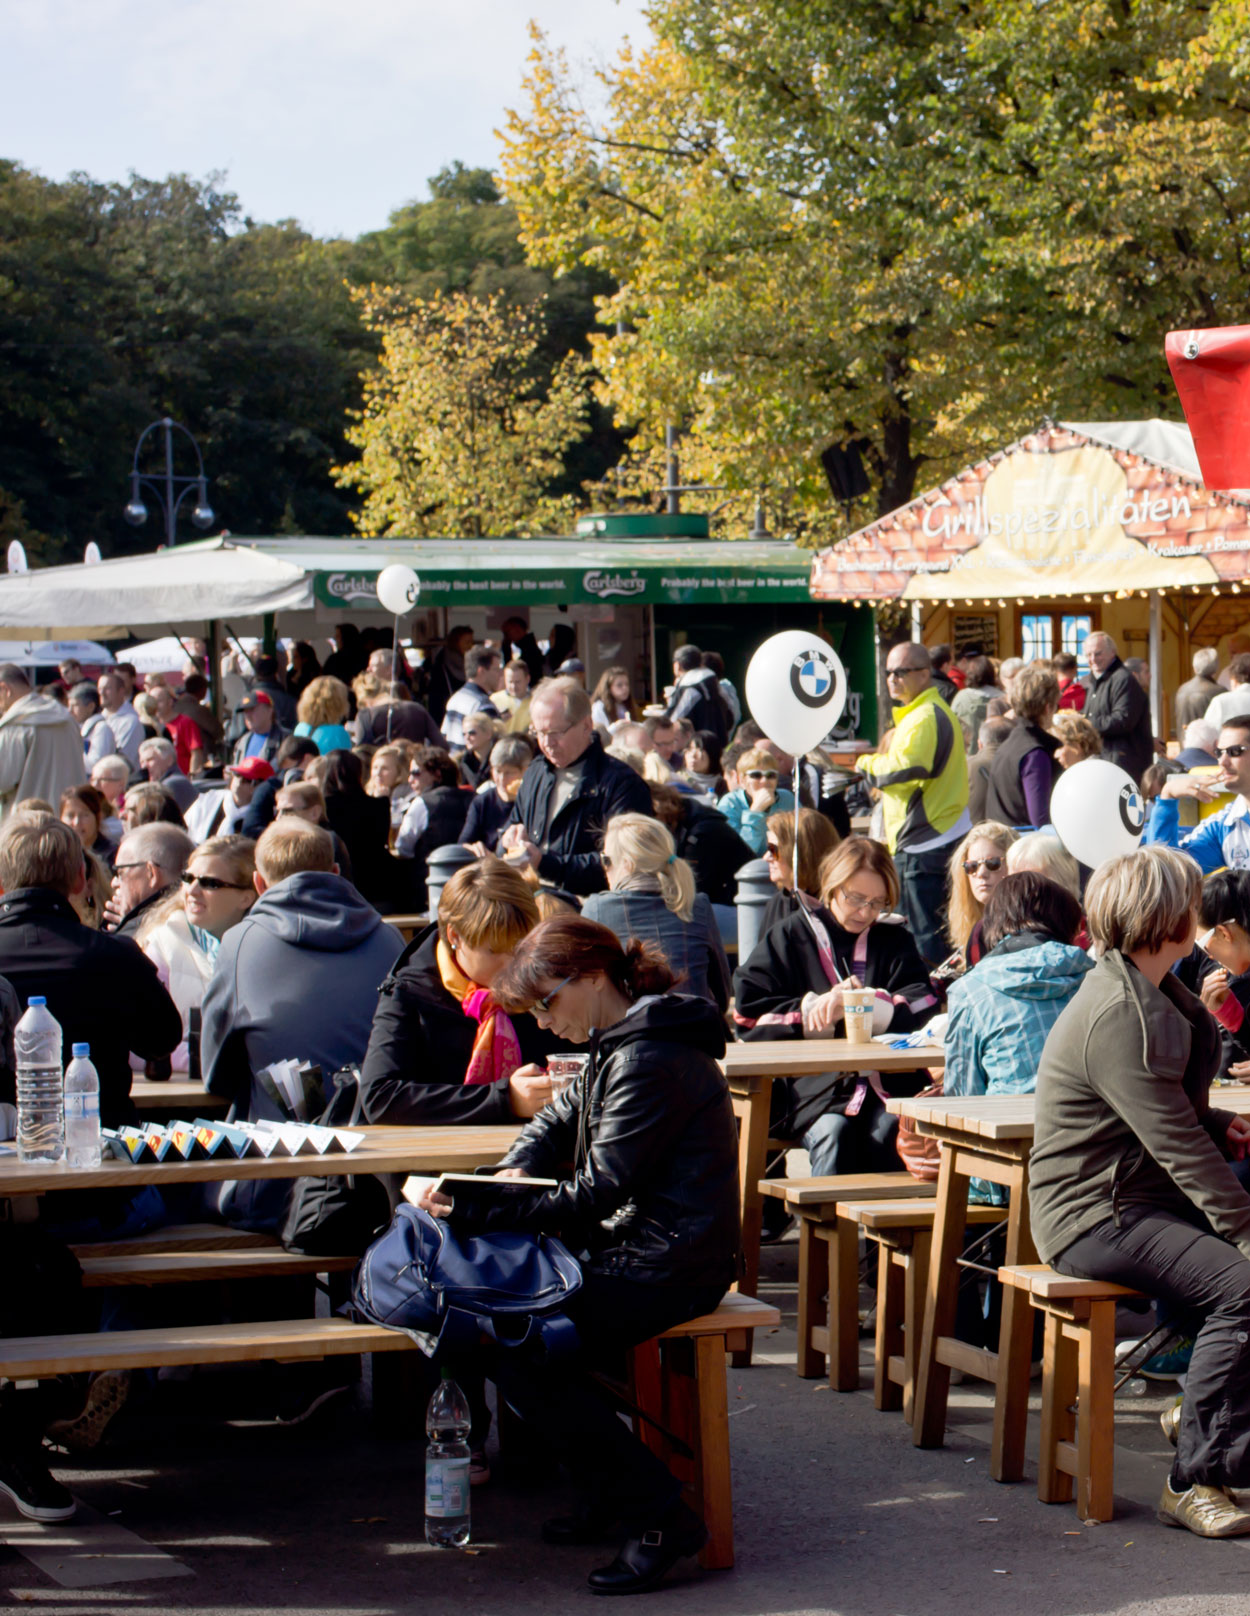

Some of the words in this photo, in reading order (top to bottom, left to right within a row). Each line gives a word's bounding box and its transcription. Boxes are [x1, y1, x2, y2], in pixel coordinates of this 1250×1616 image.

[922, 487, 1192, 549] Grillspezialitäten
[326, 573, 377, 595] Carlsbe
[420, 581, 451, 592] obably
[453, 580, 467, 591] the
[469, 580, 488, 591] best
[491, 580, 508, 591] beer
[512, 580, 520, 590] in
[522, 580, 537, 590] the
[583, 570, 646, 593] Carlsberg
[661, 577, 700, 589] Probably
[701, 577, 715, 588] the
[717, 577, 735, 588] best
[737, 577, 755, 588] beer
[757, 577, 765, 588] in
[767, 577, 780, 588] the
[782, 577, 808, 588] world.
[793, 650, 835, 671] BMW
